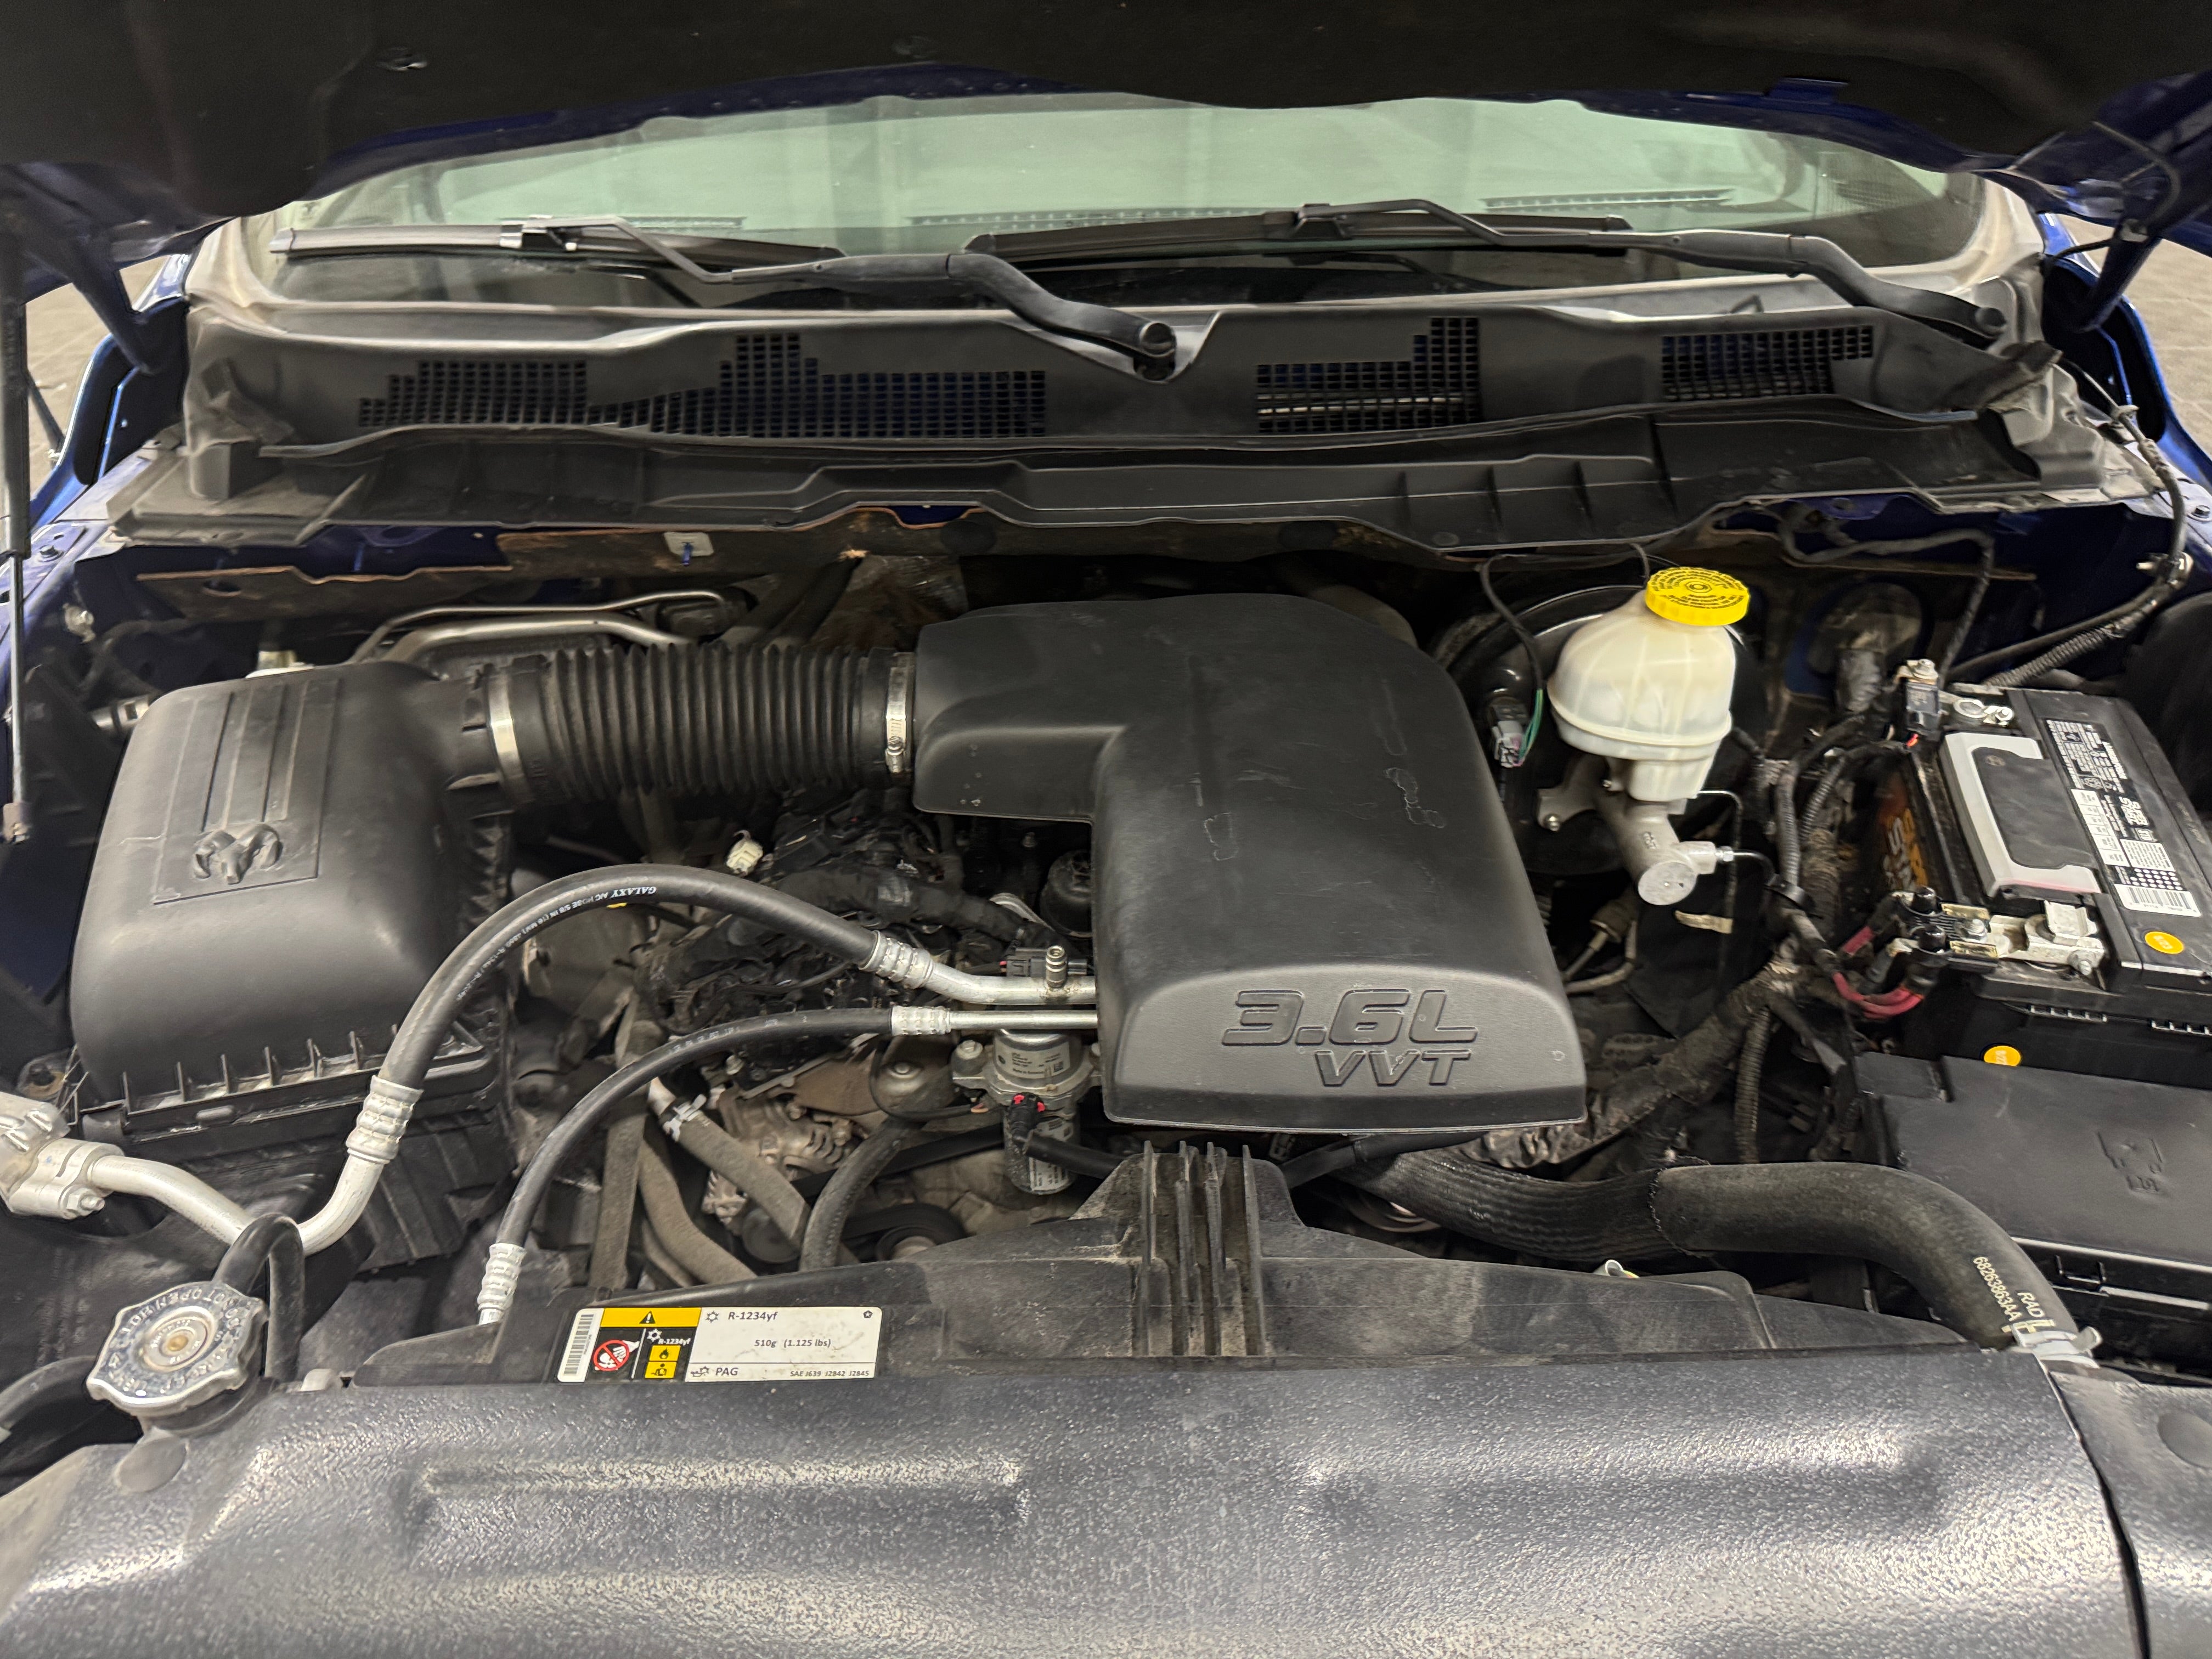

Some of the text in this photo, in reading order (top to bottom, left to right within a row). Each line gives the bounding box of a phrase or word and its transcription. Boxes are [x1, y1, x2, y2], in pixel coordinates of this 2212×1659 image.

[610, 886, 657, 898] GALAXY
[571, 896, 594, 909] HOSE
[1222, 989, 1478, 1046] 3.6L
[1314, 1049, 1472, 1087] VVT
[1973, 1256, 2023, 1322] 68263863AA
[155, 1289, 202, 1311] OPEN
[2017, 1292, 2045, 1318] RAD
[728, 1311, 778, 1322] R-1234yf
[754, 1339, 832, 1348] 510g (1.125 lbs)
[715, 1367, 739, 1376] PAG
